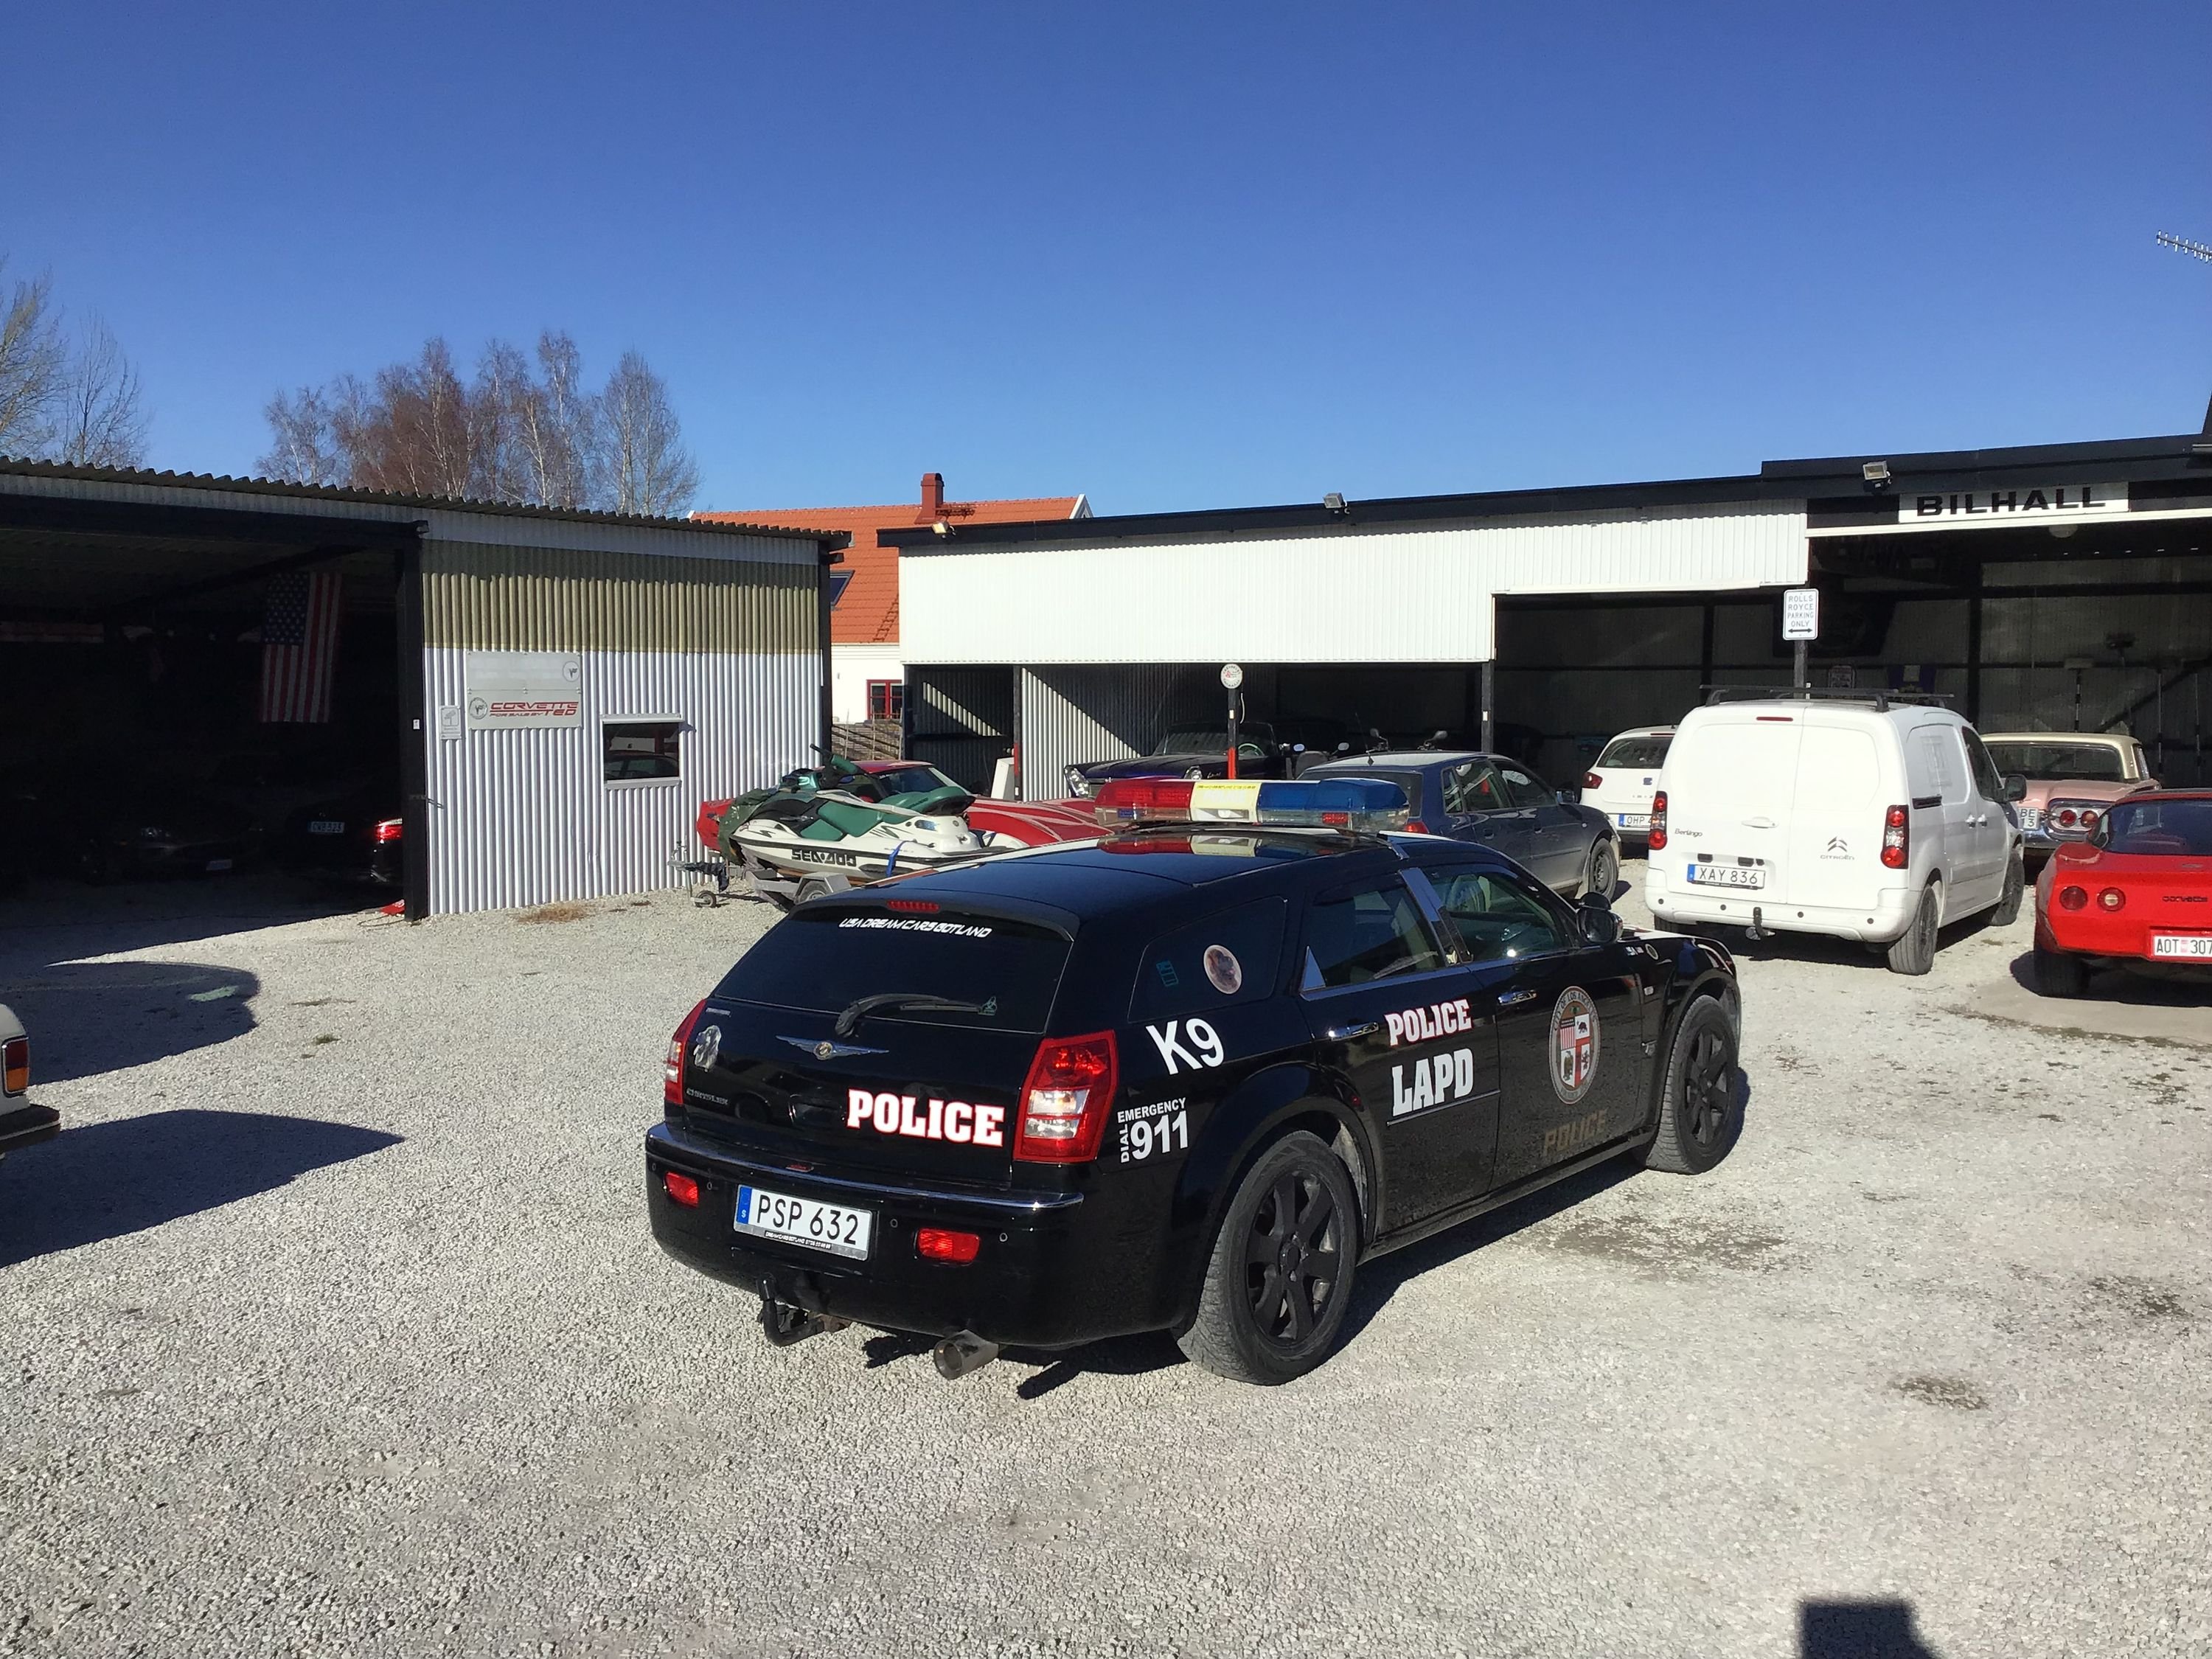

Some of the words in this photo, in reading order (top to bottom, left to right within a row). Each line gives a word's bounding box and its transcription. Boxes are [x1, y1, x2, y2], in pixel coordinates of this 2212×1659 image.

[1917, 487, 2107, 516] BILHALL
[1787, 611, 1814, 619] PARKING
[491, 701, 579, 709] CORVETTE
[1627, 815, 1645, 824] OHP
[1674, 828, 1703, 838] Berlingo
[1699, 867, 1727, 881] XAY
[1730, 870, 1758, 884] 836
[838, 918, 861, 928] USA
[860, 919, 902, 929] DREAM
[901, 919, 935, 931] CARS
[933, 922, 992, 938] GOTLAND
[2156, 939, 2180, 953] AOT
[1383, 998, 1473, 1047] POLICE
[1145, 1018, 1225, 1075] K9
[1391, 1048, 1474, 1116] LAPD
[847, 1088, 1005, 1147] POLICE
[1117, 1097, 1186, 1123] EMERGENCY
[1119, 1123, 1130, 1164] DIAL
[1130, 1110, 1189, 1160] 911
[1543, 1107, 1608, 1158] POLICE
[757, 1194, 802, 1230] PSP
[810, 1207, 858, 1245] 632
